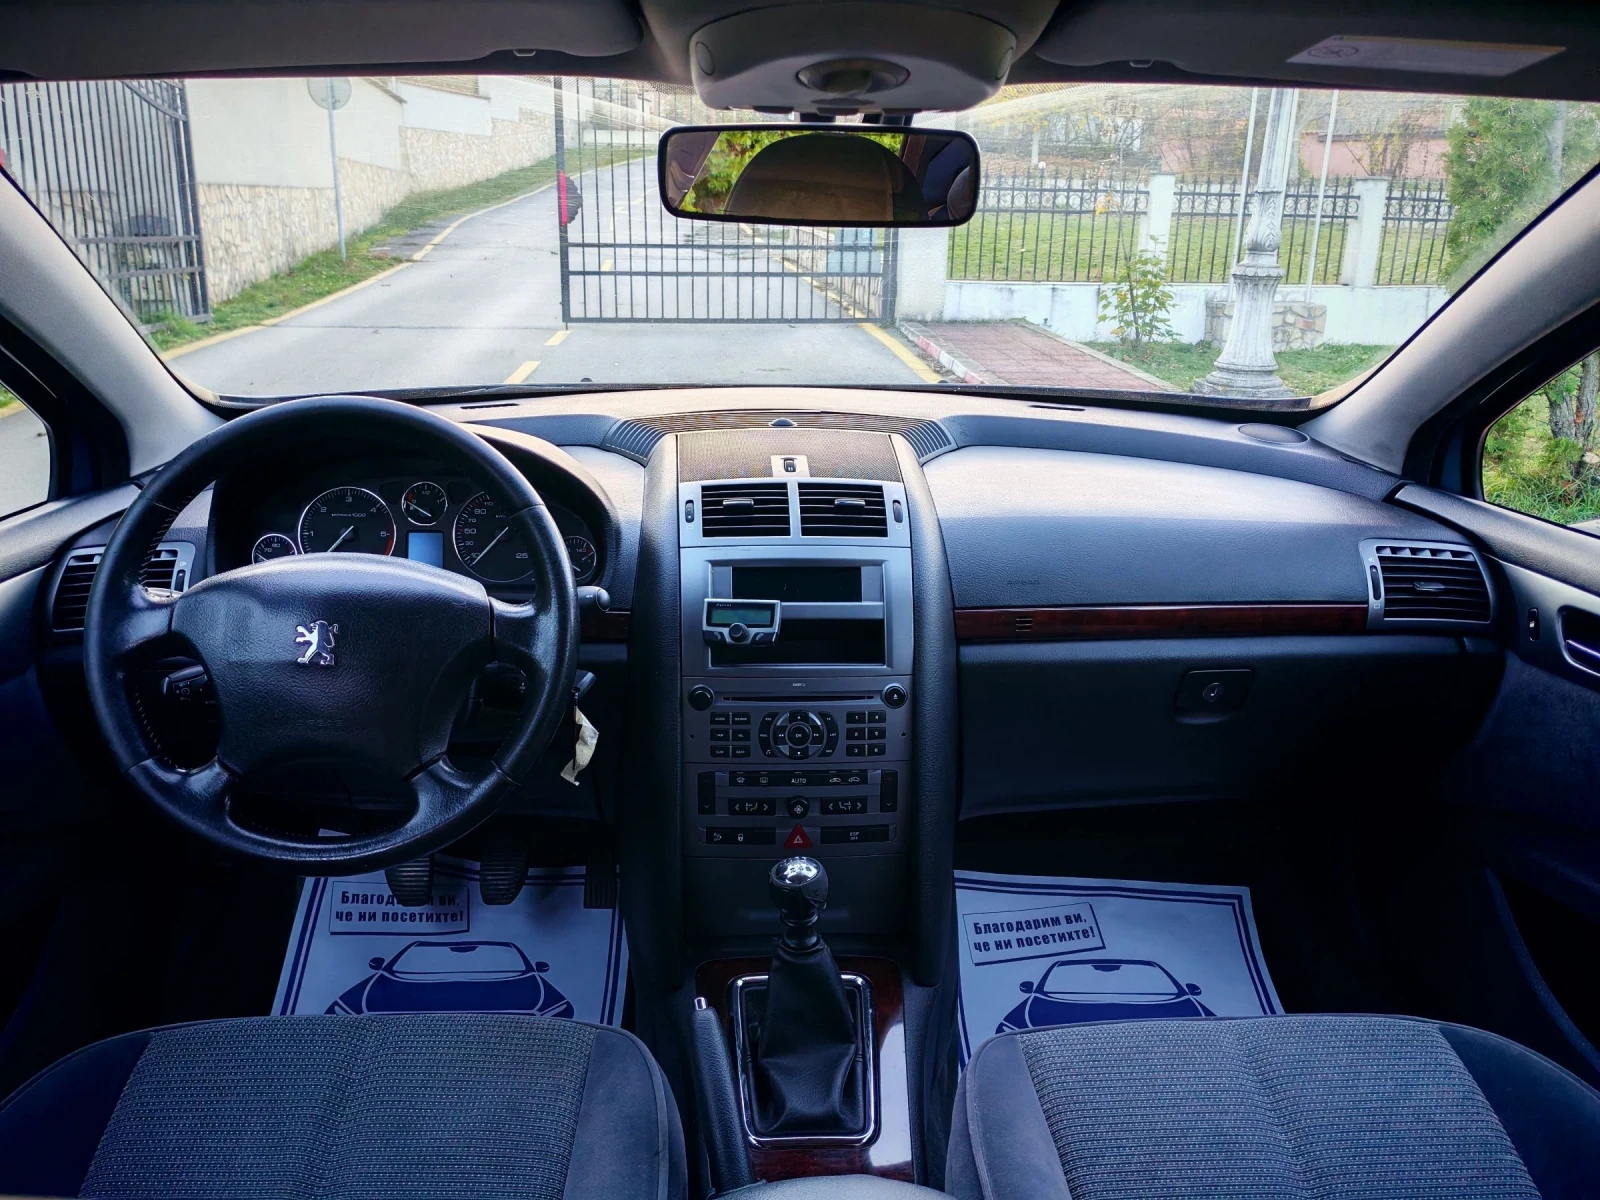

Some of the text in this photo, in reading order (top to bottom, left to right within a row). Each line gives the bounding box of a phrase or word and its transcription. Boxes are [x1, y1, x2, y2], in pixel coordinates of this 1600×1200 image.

[335, 910, 464, 923] че ни посетихте!
[973, 913, 1087, 935] Благодарим ви,
[973, 925, 1096, 953] че ни посетихте!
